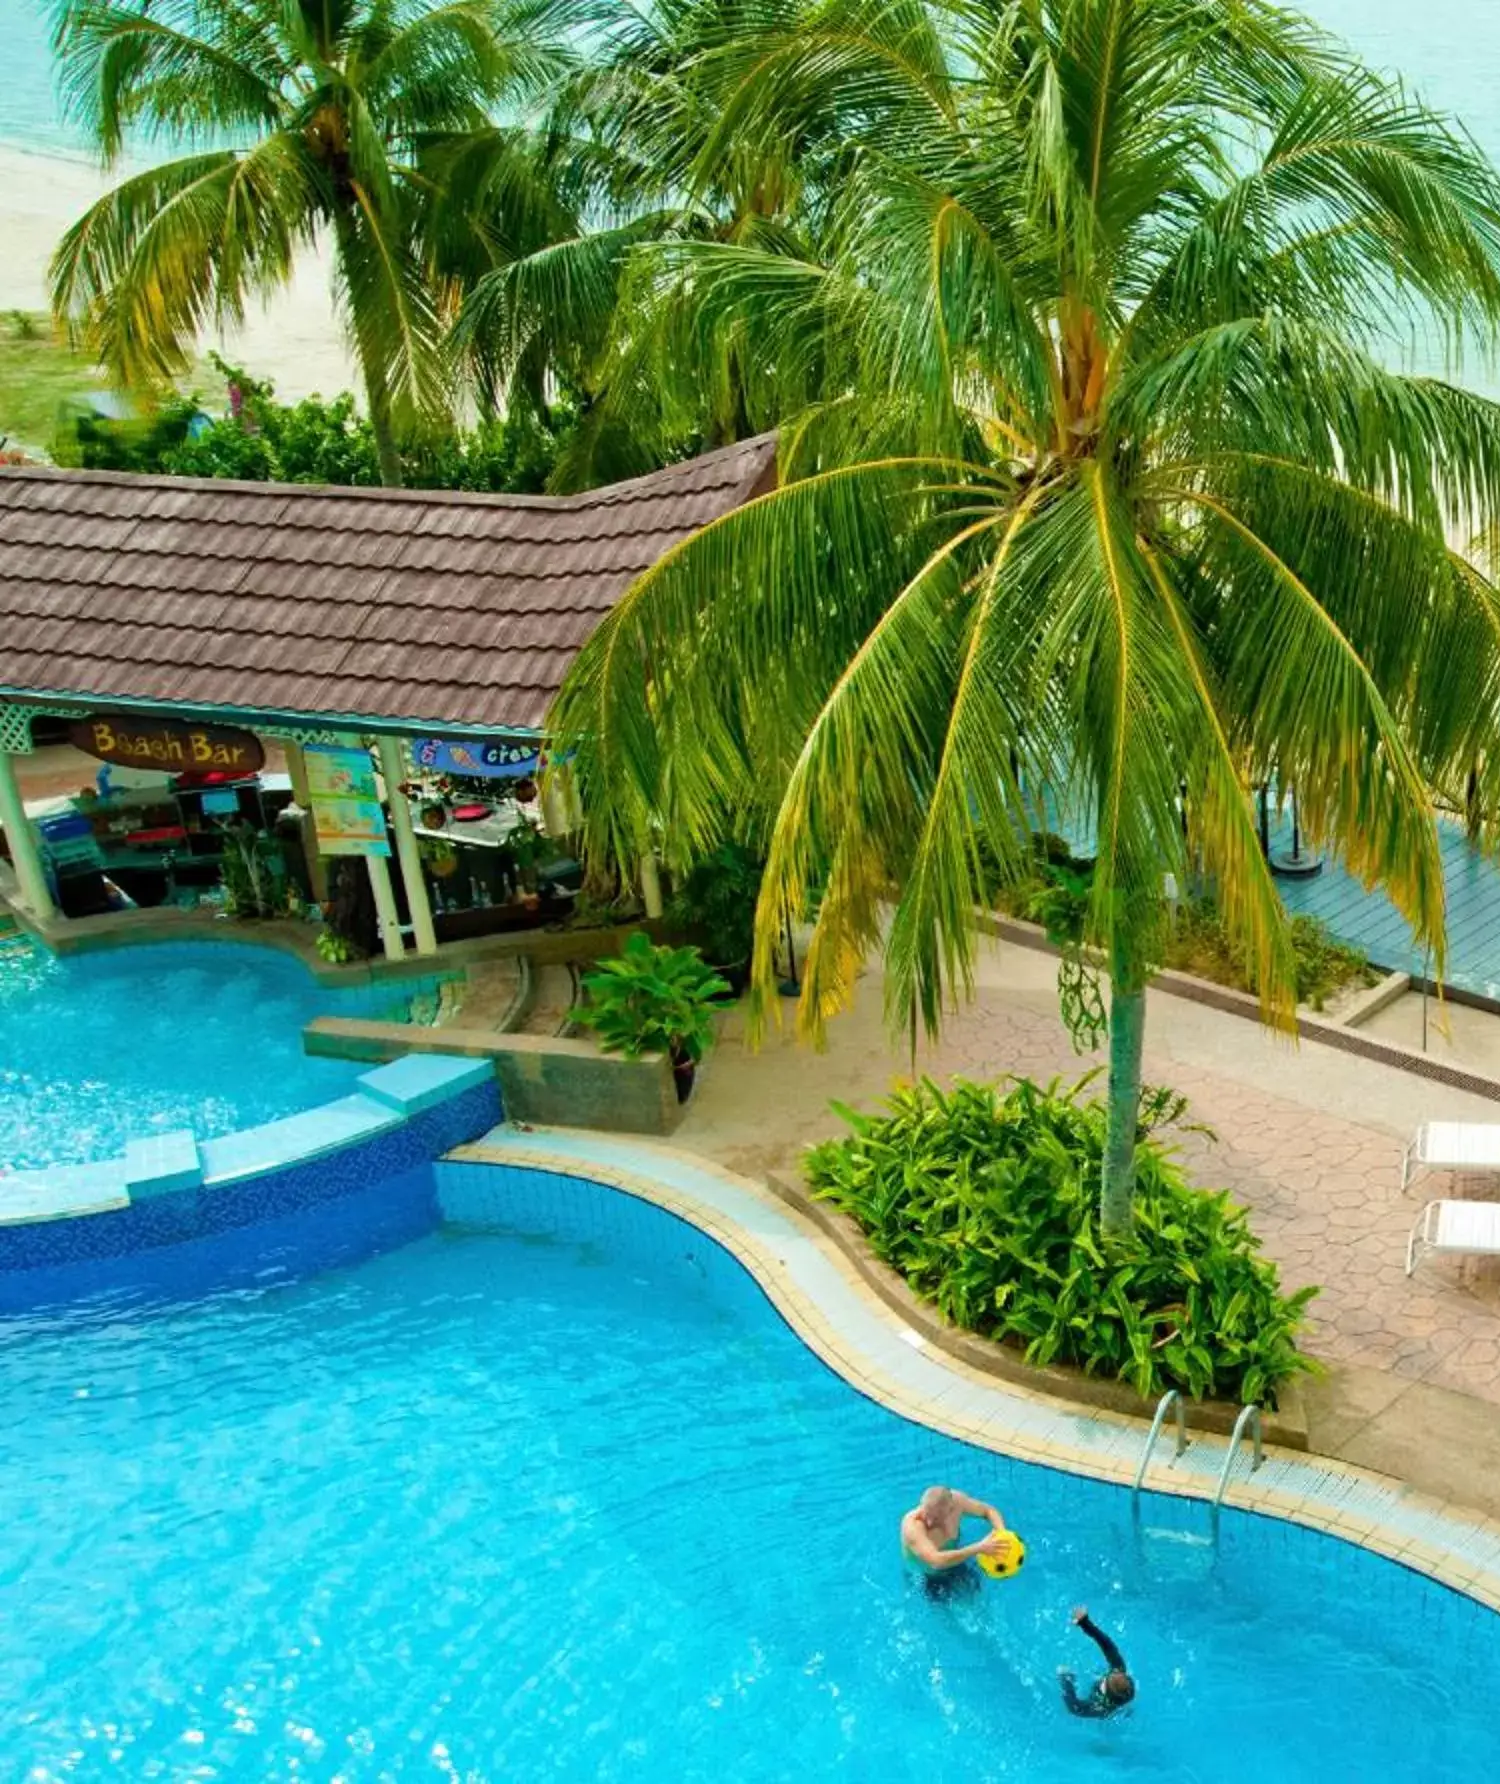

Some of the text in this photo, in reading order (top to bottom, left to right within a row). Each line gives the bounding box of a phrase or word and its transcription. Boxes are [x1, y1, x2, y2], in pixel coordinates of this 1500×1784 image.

[93, 723, 244, 765] Beach Bar
[487, 745, 538, 764] crea
